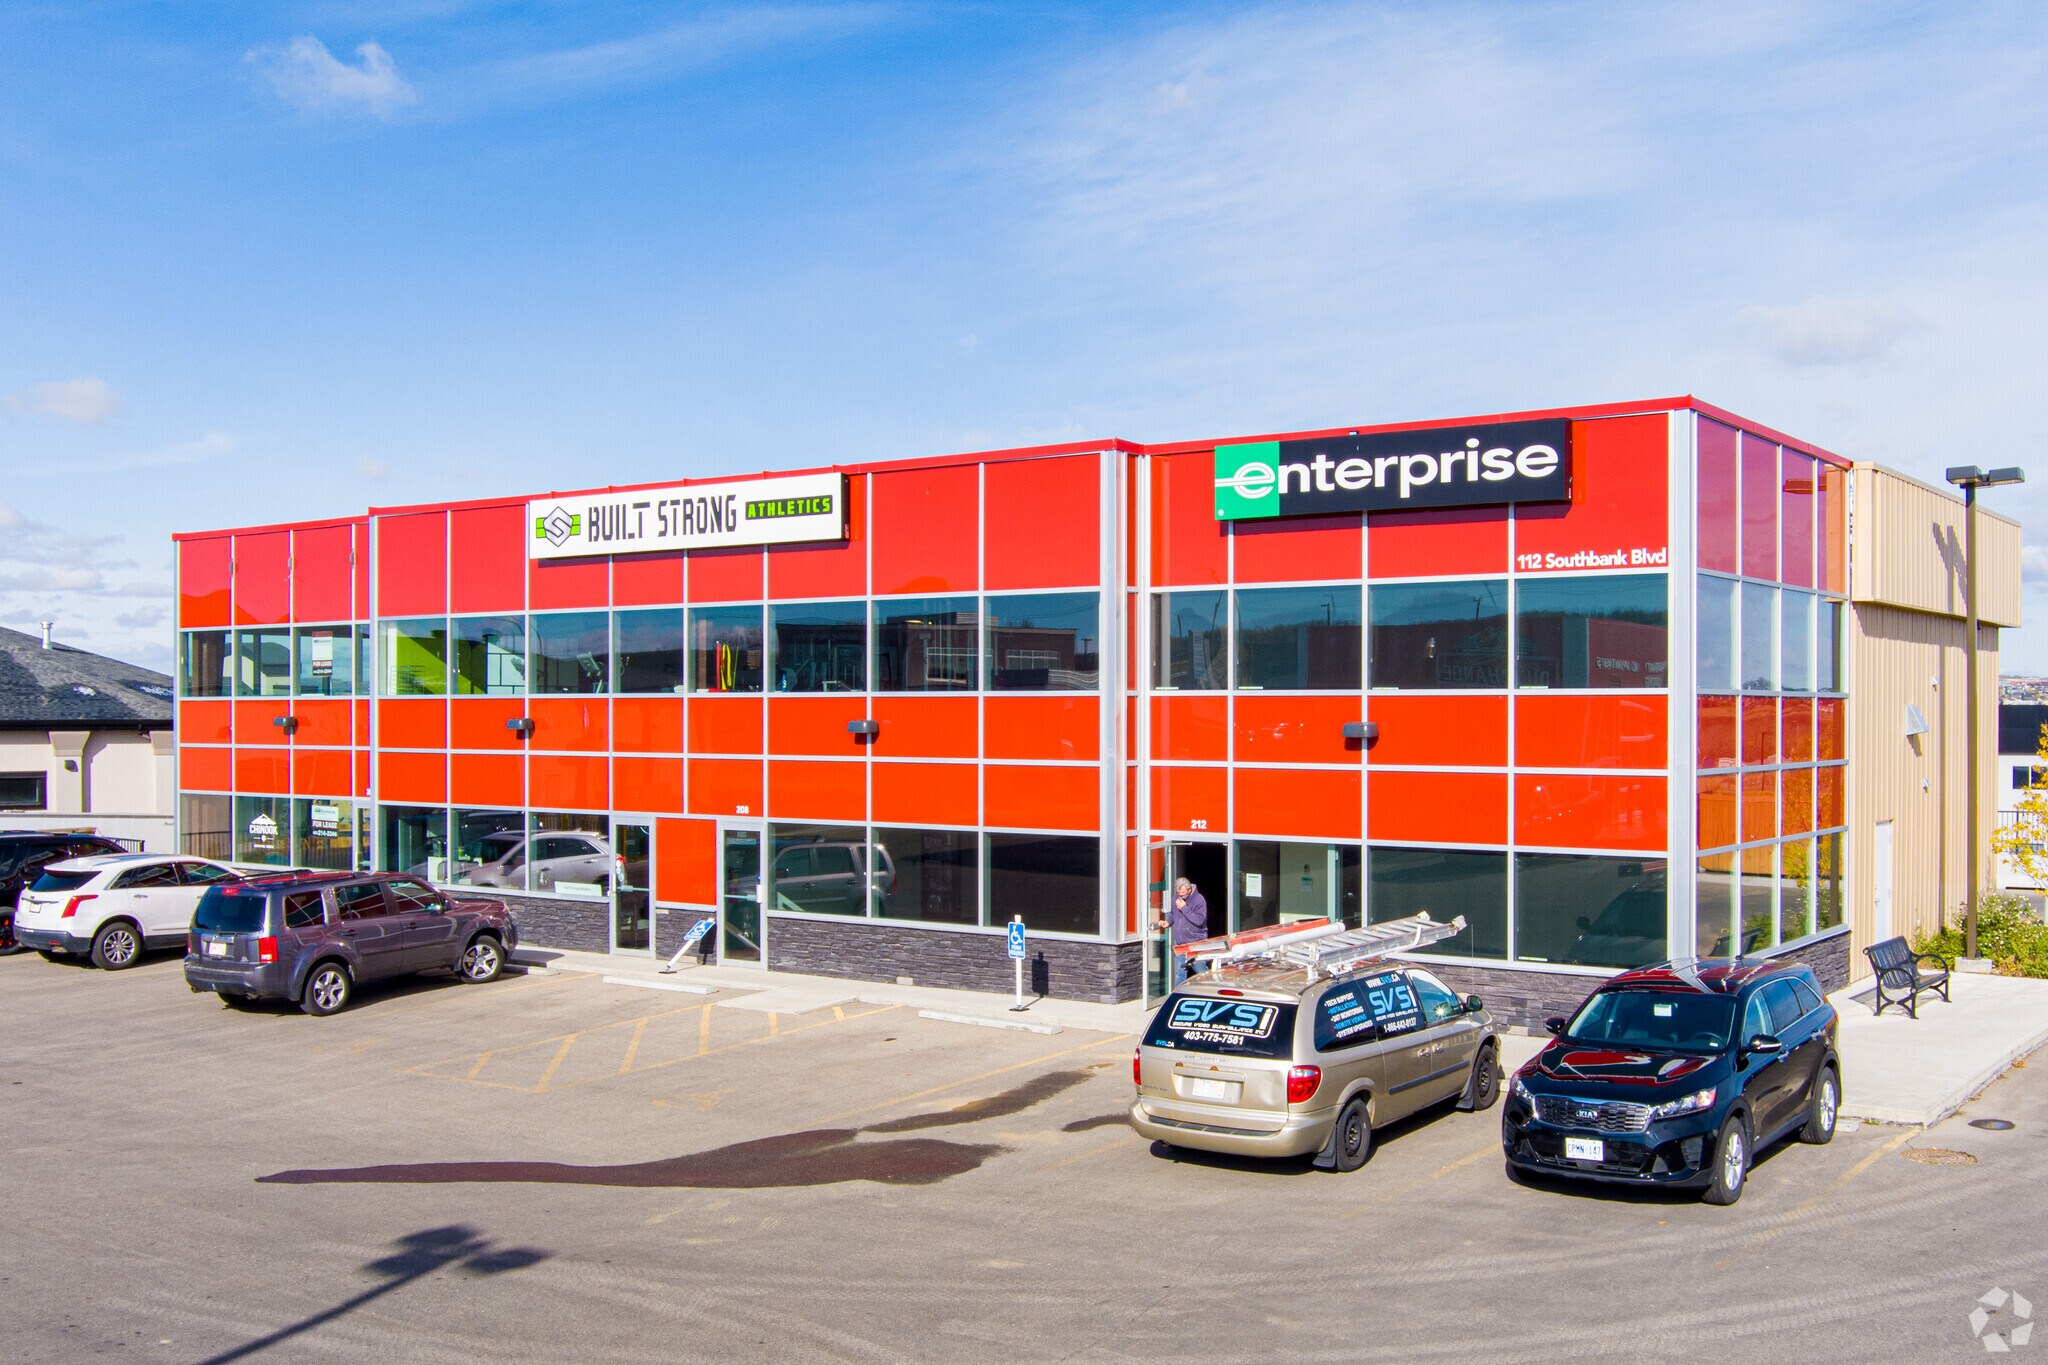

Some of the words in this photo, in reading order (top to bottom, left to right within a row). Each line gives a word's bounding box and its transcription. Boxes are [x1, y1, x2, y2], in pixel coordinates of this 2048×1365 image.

[1215, 438, 1559, 499] enterprise
[747, 497, 831, 519] ATHLETICS
[588, 501, 651, 542] BUILT
[657, 494, 737, 537] STRONG
[1517, 553, 1543, 569] 112
[1545, 549, 1628, 569] Southbank
[1631, 547, 1667, 565] Blvd
[736, 805, 749, 814] 208
[249, 824, 279, 835] CHINOOK
[322, 821, 338, 829] LEASE
[1191, 819, 1207, 829] 212
[1184, 1031, 1244, 1045] 403-775-7581
[1579, 1110, 1593, 1118] KIA
